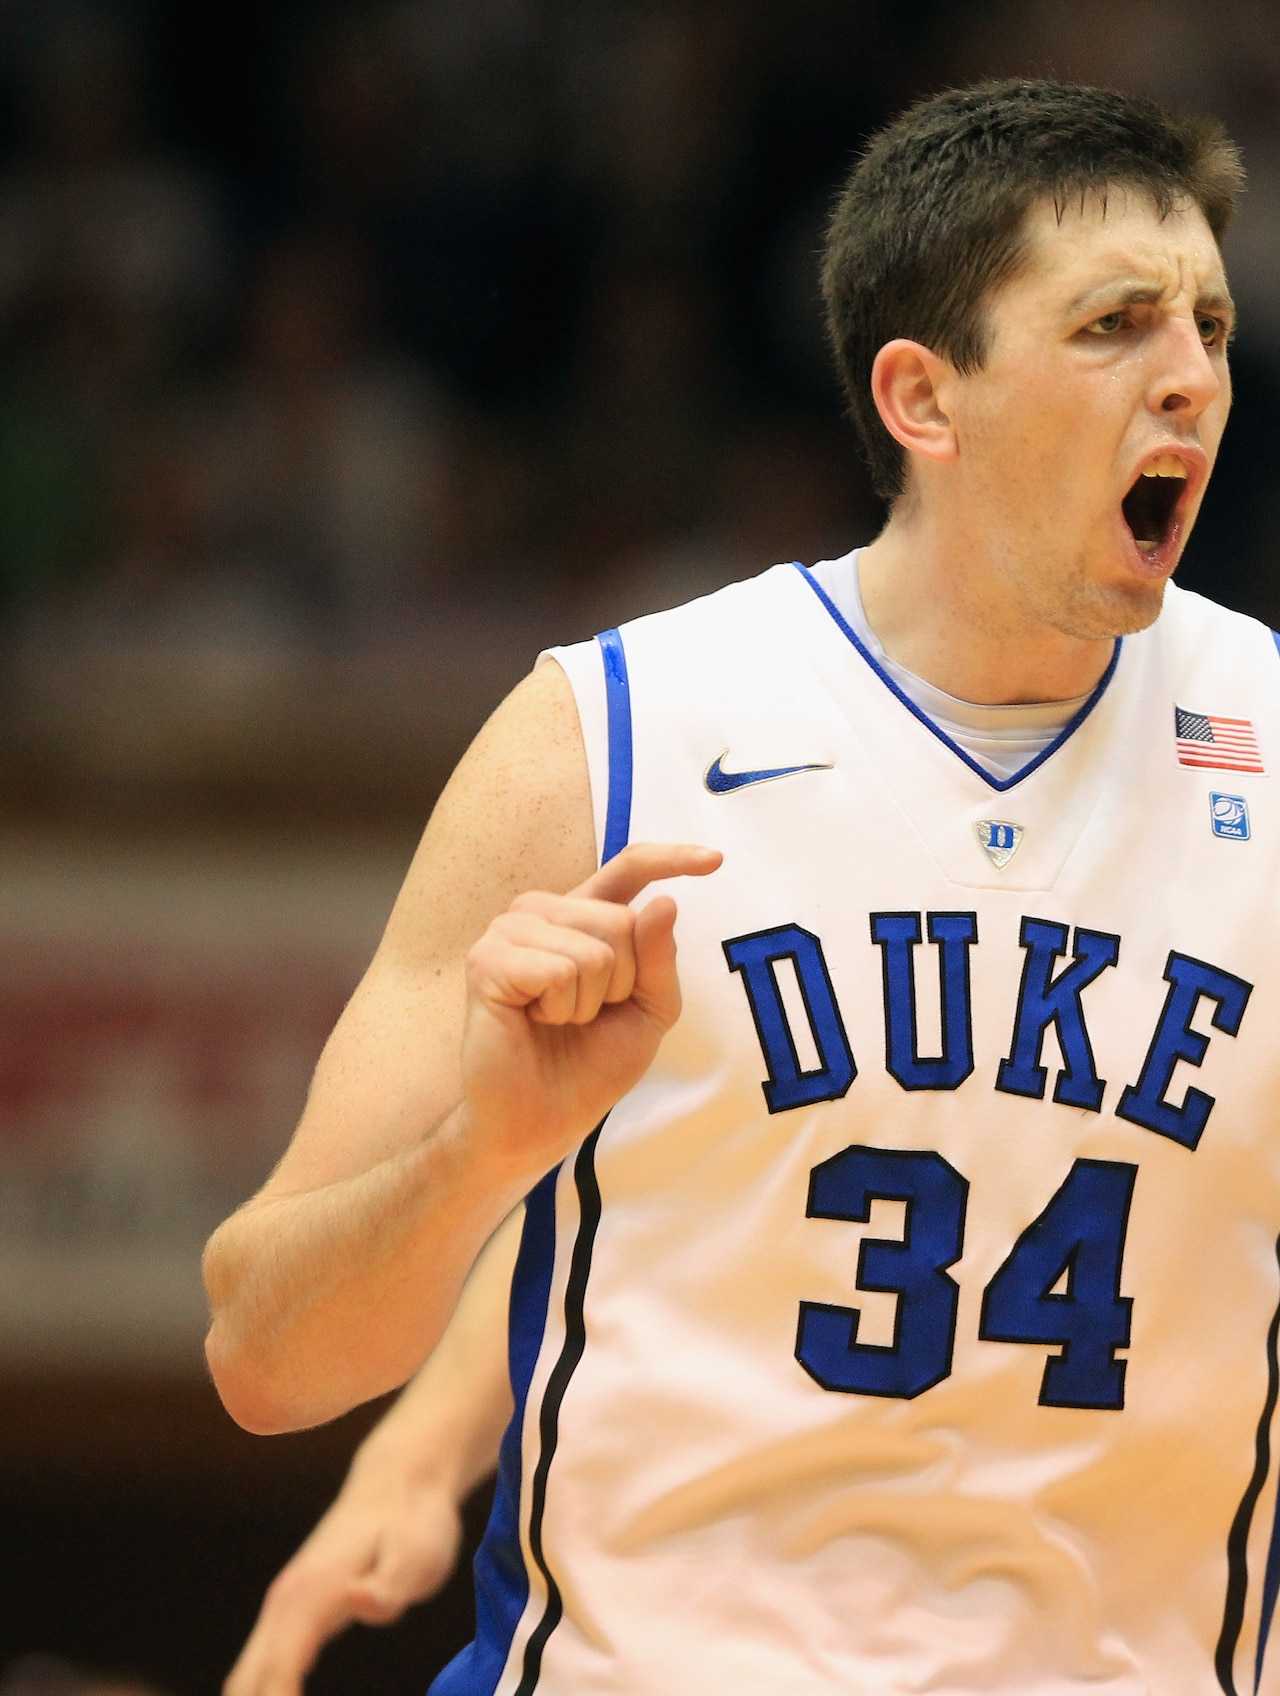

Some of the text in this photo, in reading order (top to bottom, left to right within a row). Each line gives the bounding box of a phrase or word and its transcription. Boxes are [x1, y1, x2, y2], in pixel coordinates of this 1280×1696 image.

[988, 823, 1014, 849] D
[1220, 825, 1242, 836] NCAA
[721, 910, 1255, 1153] DUKE
[793, 1143, 1139, 1412] 34
